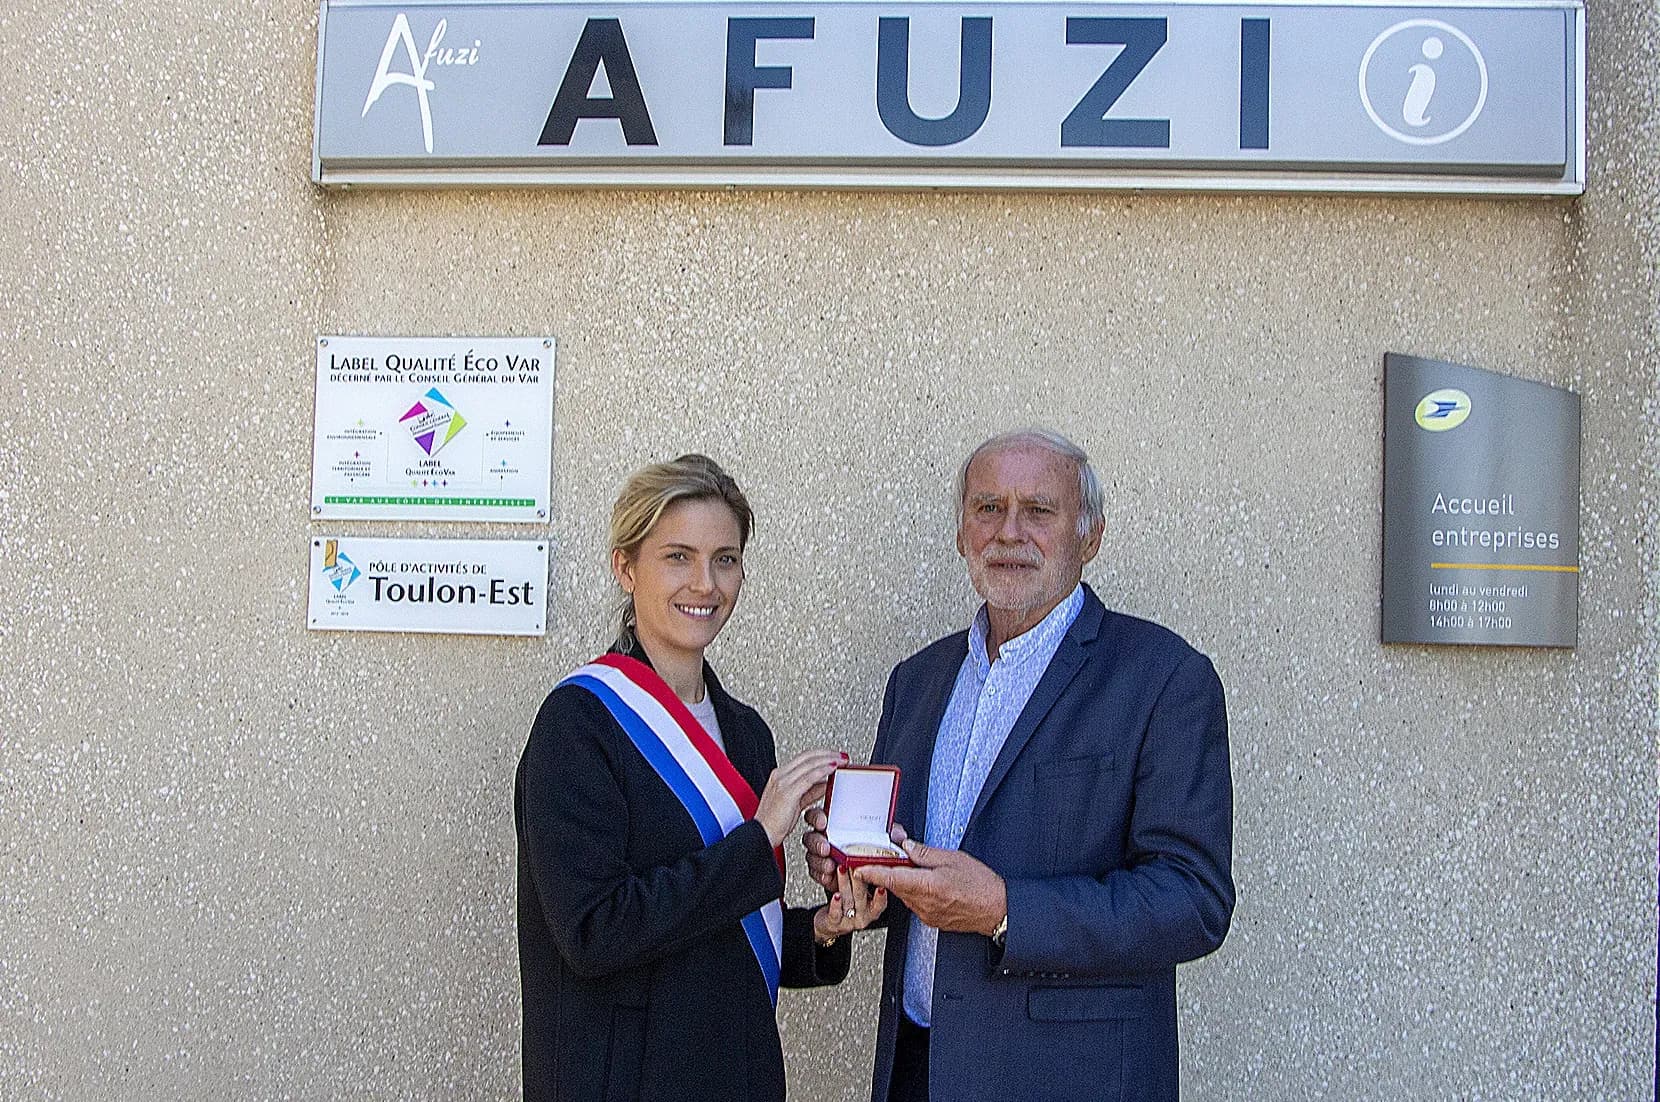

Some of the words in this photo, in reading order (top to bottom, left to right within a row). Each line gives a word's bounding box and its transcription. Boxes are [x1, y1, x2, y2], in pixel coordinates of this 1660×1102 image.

[361, 12, 481, 154] Afuzi
[536, 16, 1271, 149] AFUZI
[1431, 493, 1515, 516] Accueil
[1431, 526, 1560, 552] entreprises
[369, 560, 397, 574] PÔLE
[472, 564, 487, 575] DE
[368, 576, 534, 606] Toulon-Est
[1429, 583, 1459, 596] lundi
[1462, 586, 1476, 596] au
[1479, 584, 1528, 597] vendredi
[1472, 600, 1506, 613] 12h00
[1430, 615, 1465, 628] 14h00
[1479, 616, 1512, 629] 17h00
